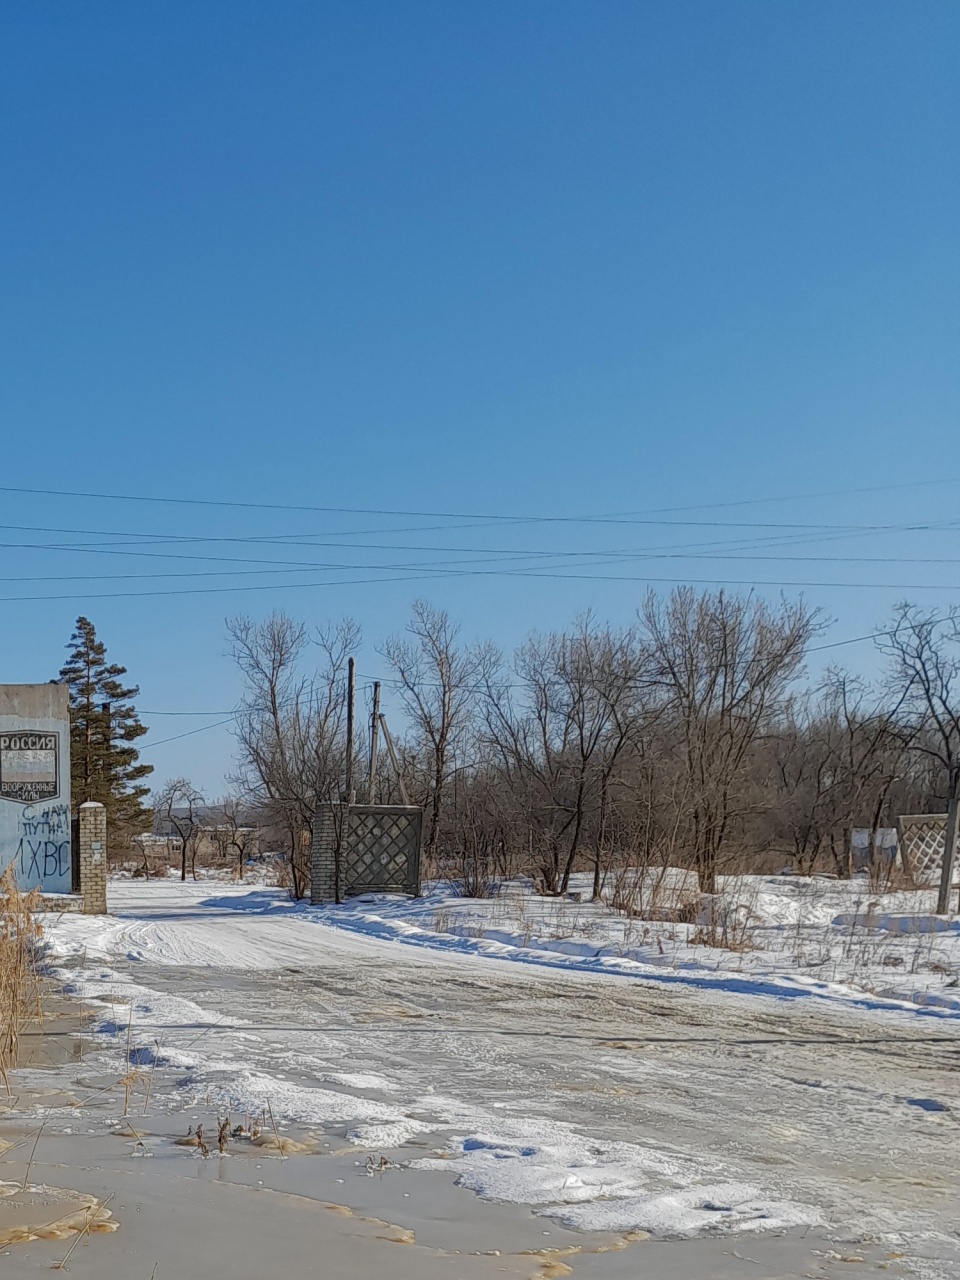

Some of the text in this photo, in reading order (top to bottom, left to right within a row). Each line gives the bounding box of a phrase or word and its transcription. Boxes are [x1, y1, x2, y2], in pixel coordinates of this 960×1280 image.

[0, 737, 56, 750] РОССИЯ
[1, 782, 56, 792] ВООРУЖЕННЫЕ
[17, 791, 40, 800] СИЛЫ
[22, 805, 37, 821] С
